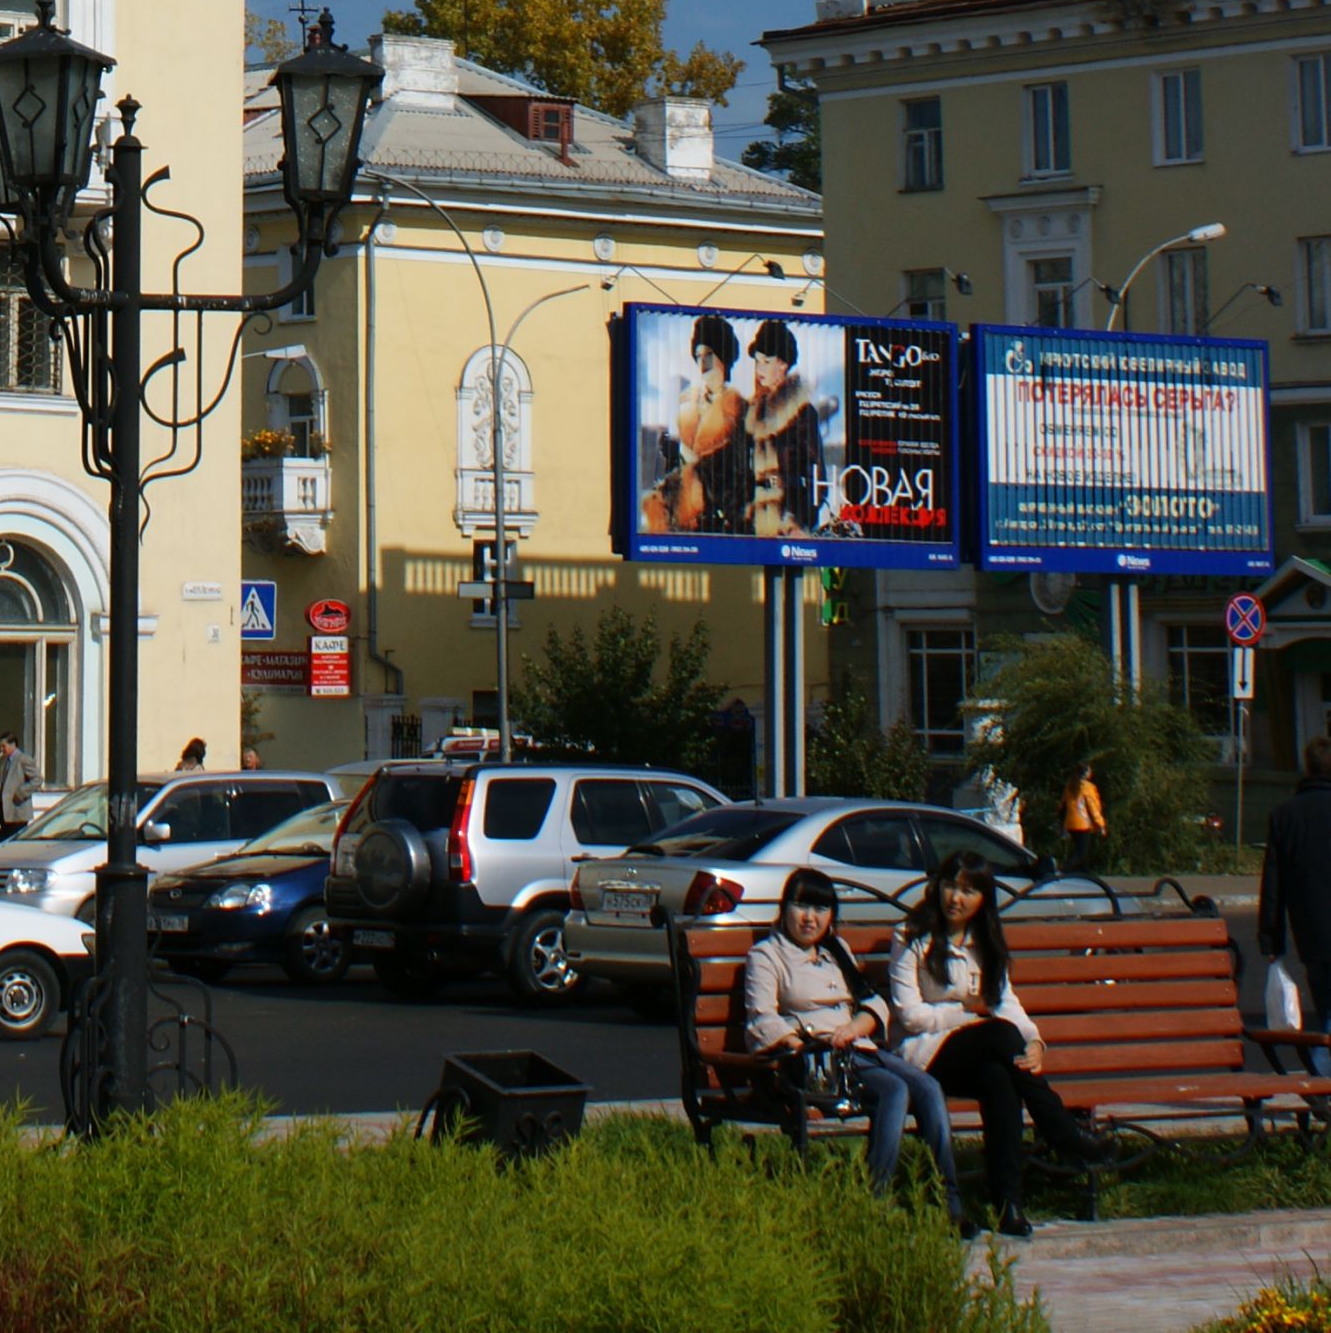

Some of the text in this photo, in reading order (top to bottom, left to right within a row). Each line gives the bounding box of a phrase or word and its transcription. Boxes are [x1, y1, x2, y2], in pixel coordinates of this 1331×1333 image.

[1018, 380, 1147, 409] ПОТЕРЯЛАСЬ
[812, 463, 934, 511] НОВАЯ
[314, 640, 346, 651] КАФЕ
